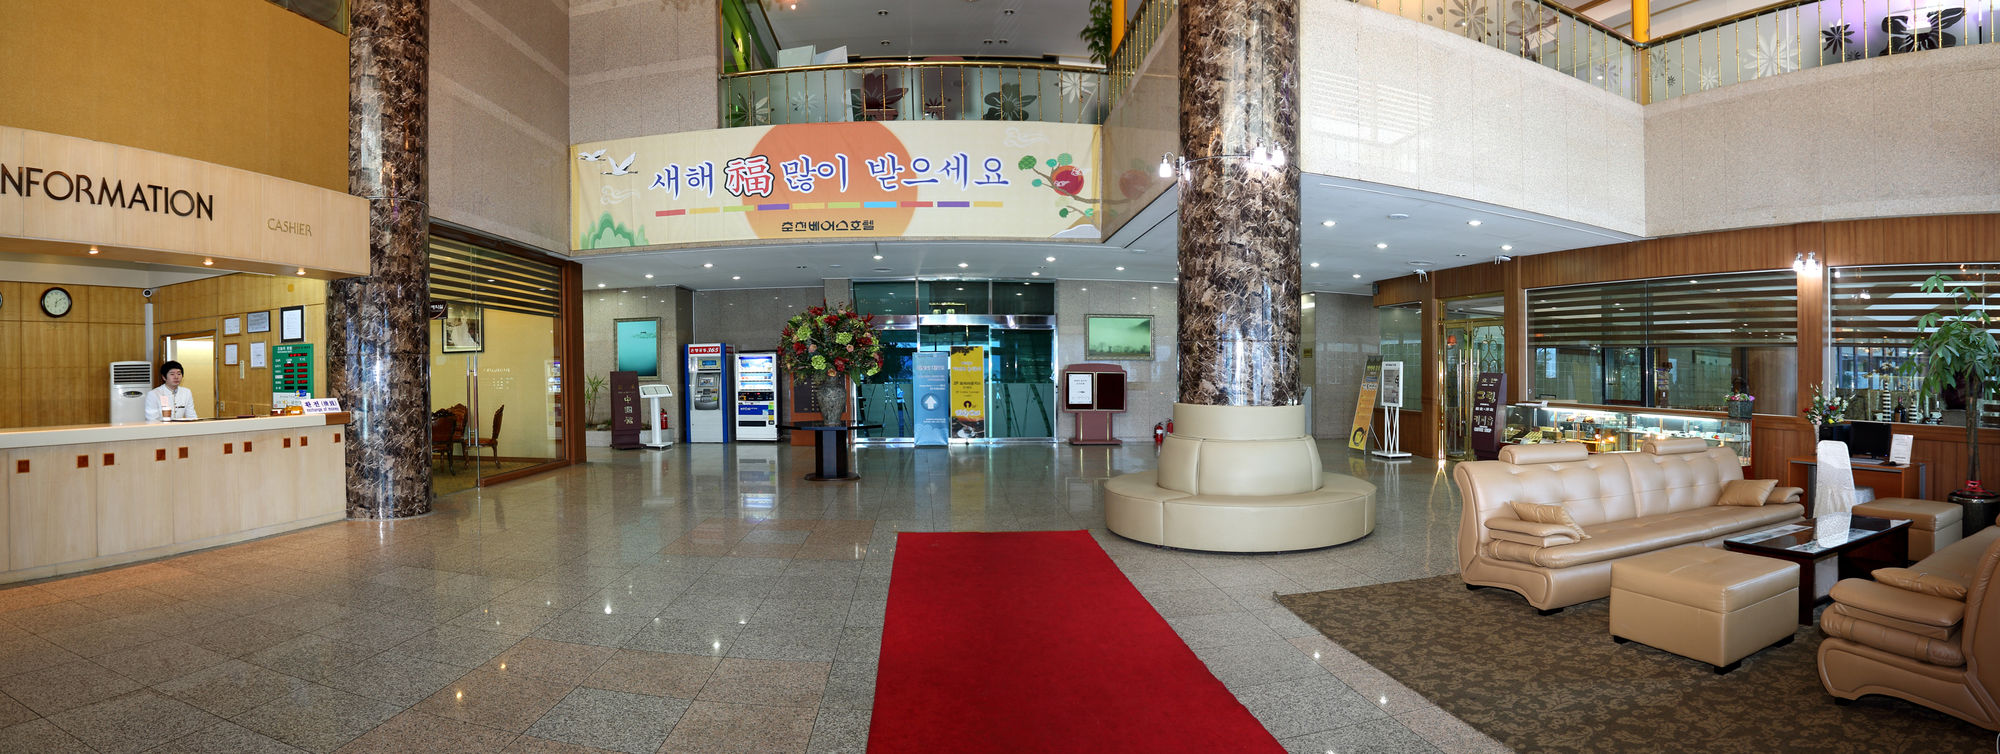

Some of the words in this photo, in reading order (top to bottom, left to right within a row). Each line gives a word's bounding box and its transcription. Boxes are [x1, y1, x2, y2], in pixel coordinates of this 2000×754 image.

[650, 161, 714, 199] 새해
[726, 156, 774, 198] 福
[781, 154, 848, 192] 많이
[867, 152, 1010, 191] 받으세요
[267, 218, 313, 237] CASHIER
[782, 220, 875, 232] 춘천베어스호텔
